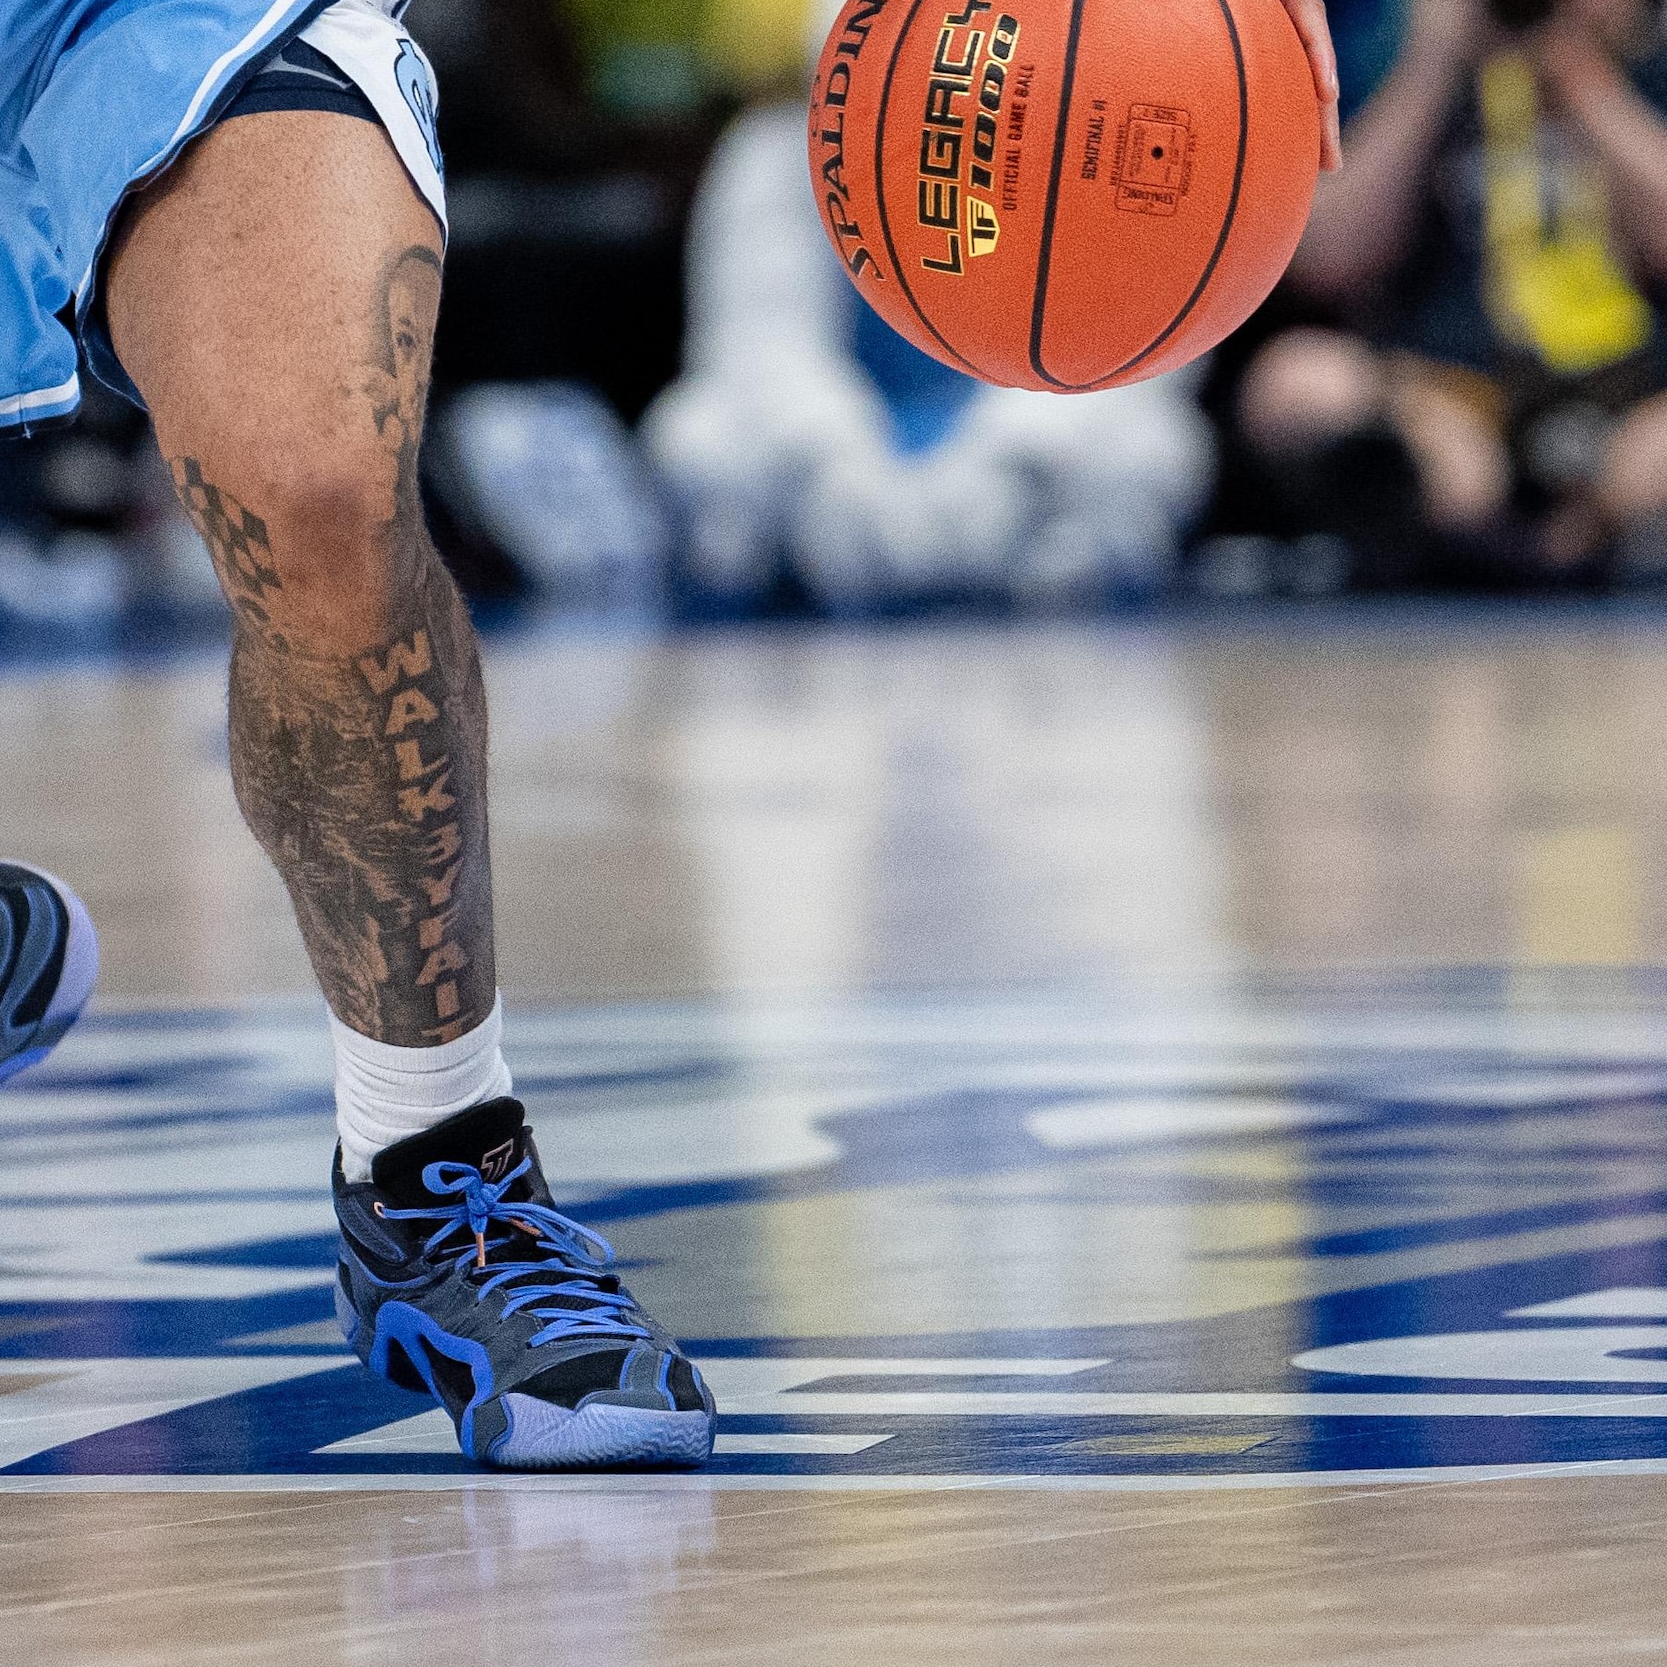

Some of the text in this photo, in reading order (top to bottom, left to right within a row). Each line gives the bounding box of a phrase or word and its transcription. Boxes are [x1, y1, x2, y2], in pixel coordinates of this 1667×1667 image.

[968, 12, 1020, 257] TF 1000
[1002, 64, 1035, 211] OFFICIAL GAME BALL
[1080, 116, 1105, 181] SEMIFINAL
